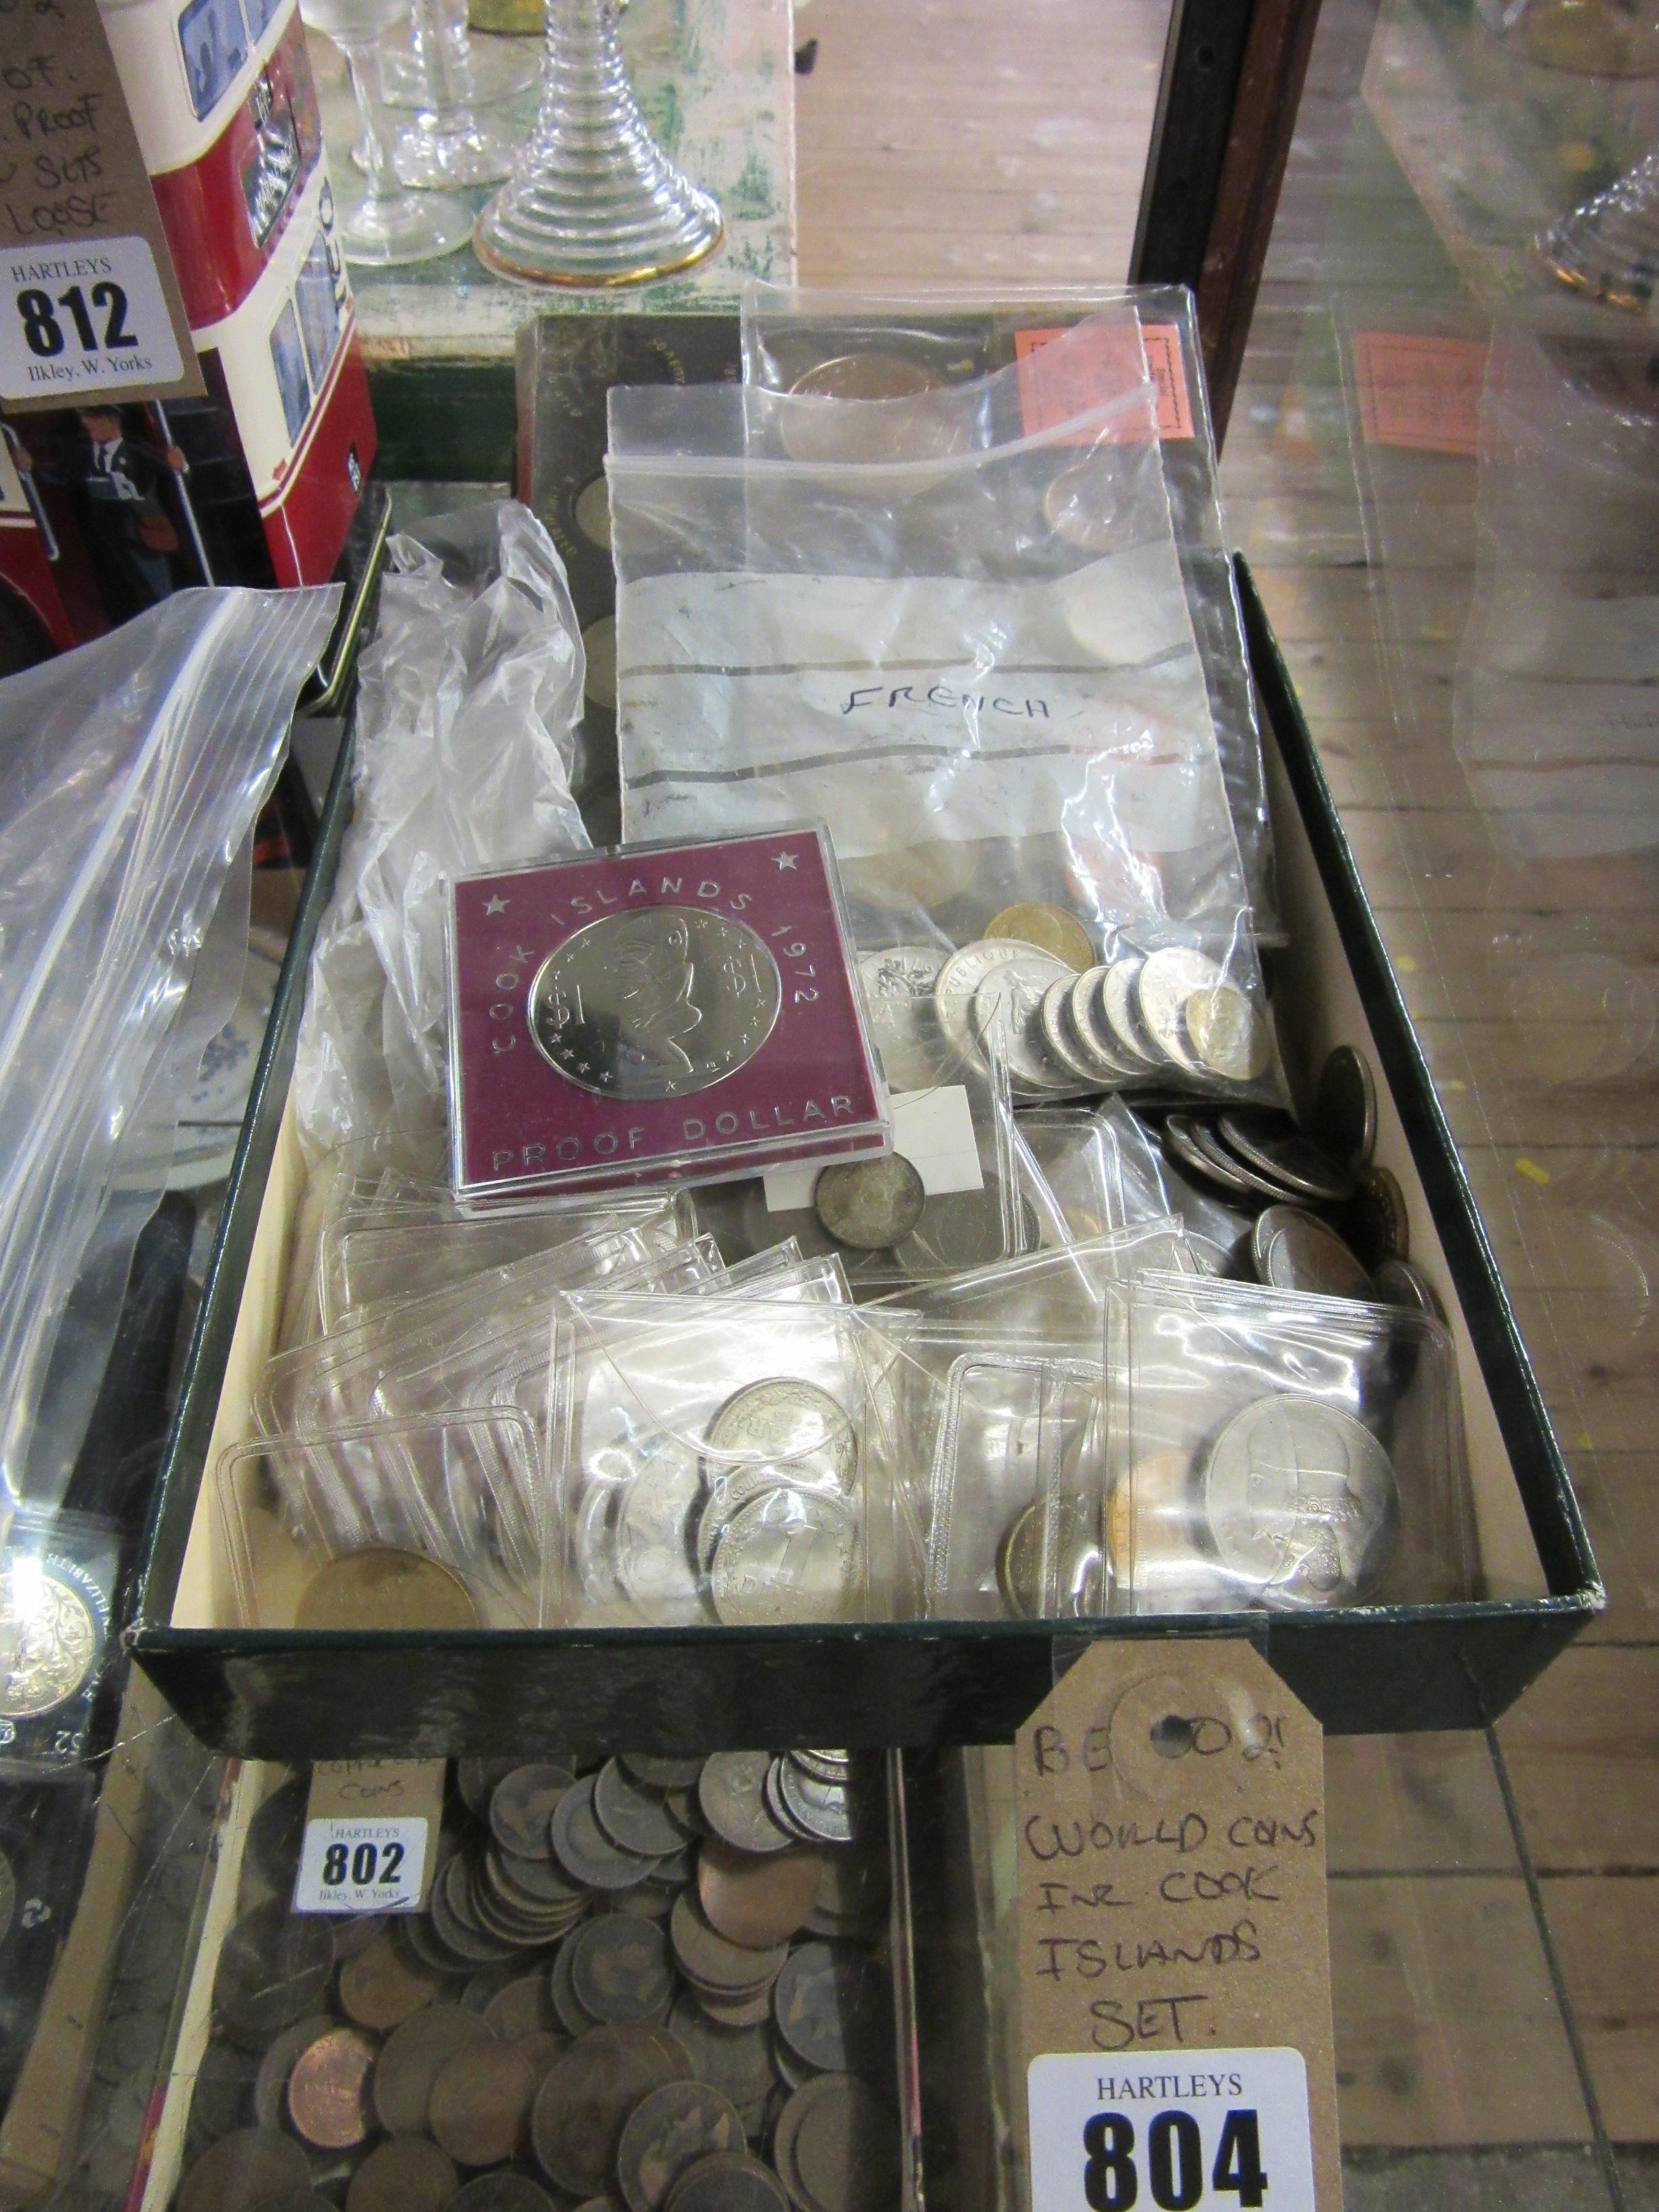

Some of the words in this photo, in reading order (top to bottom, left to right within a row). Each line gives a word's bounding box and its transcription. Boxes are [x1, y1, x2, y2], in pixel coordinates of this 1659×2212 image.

[11, 257, 112, 283] HARTLEYS
[16, 281, 139, 357] 812
[81, 359, 105, 375] W.
[106, 355, 153, 373] Yorks
[840, 685, 1050, 718] FRENCH
[489, 944, 535, 1054] COOK
[551, 876, 753, 926] ISLANDS
[771, 925, 821, 1004] 1972
[492, 1127, 647, 1172] PROOF
[683, 1095, 855, 1141] DOLLAR
[334, 1827, 401, 1839] HARTLEYS
[1025, 1812, 1208, 1862] WORLD
[322, 1841, 405, 1886] 802
[1097, 2073, 1244, 2101] HARTLEYS
[1083, 2108, 1269, 2212] 804
